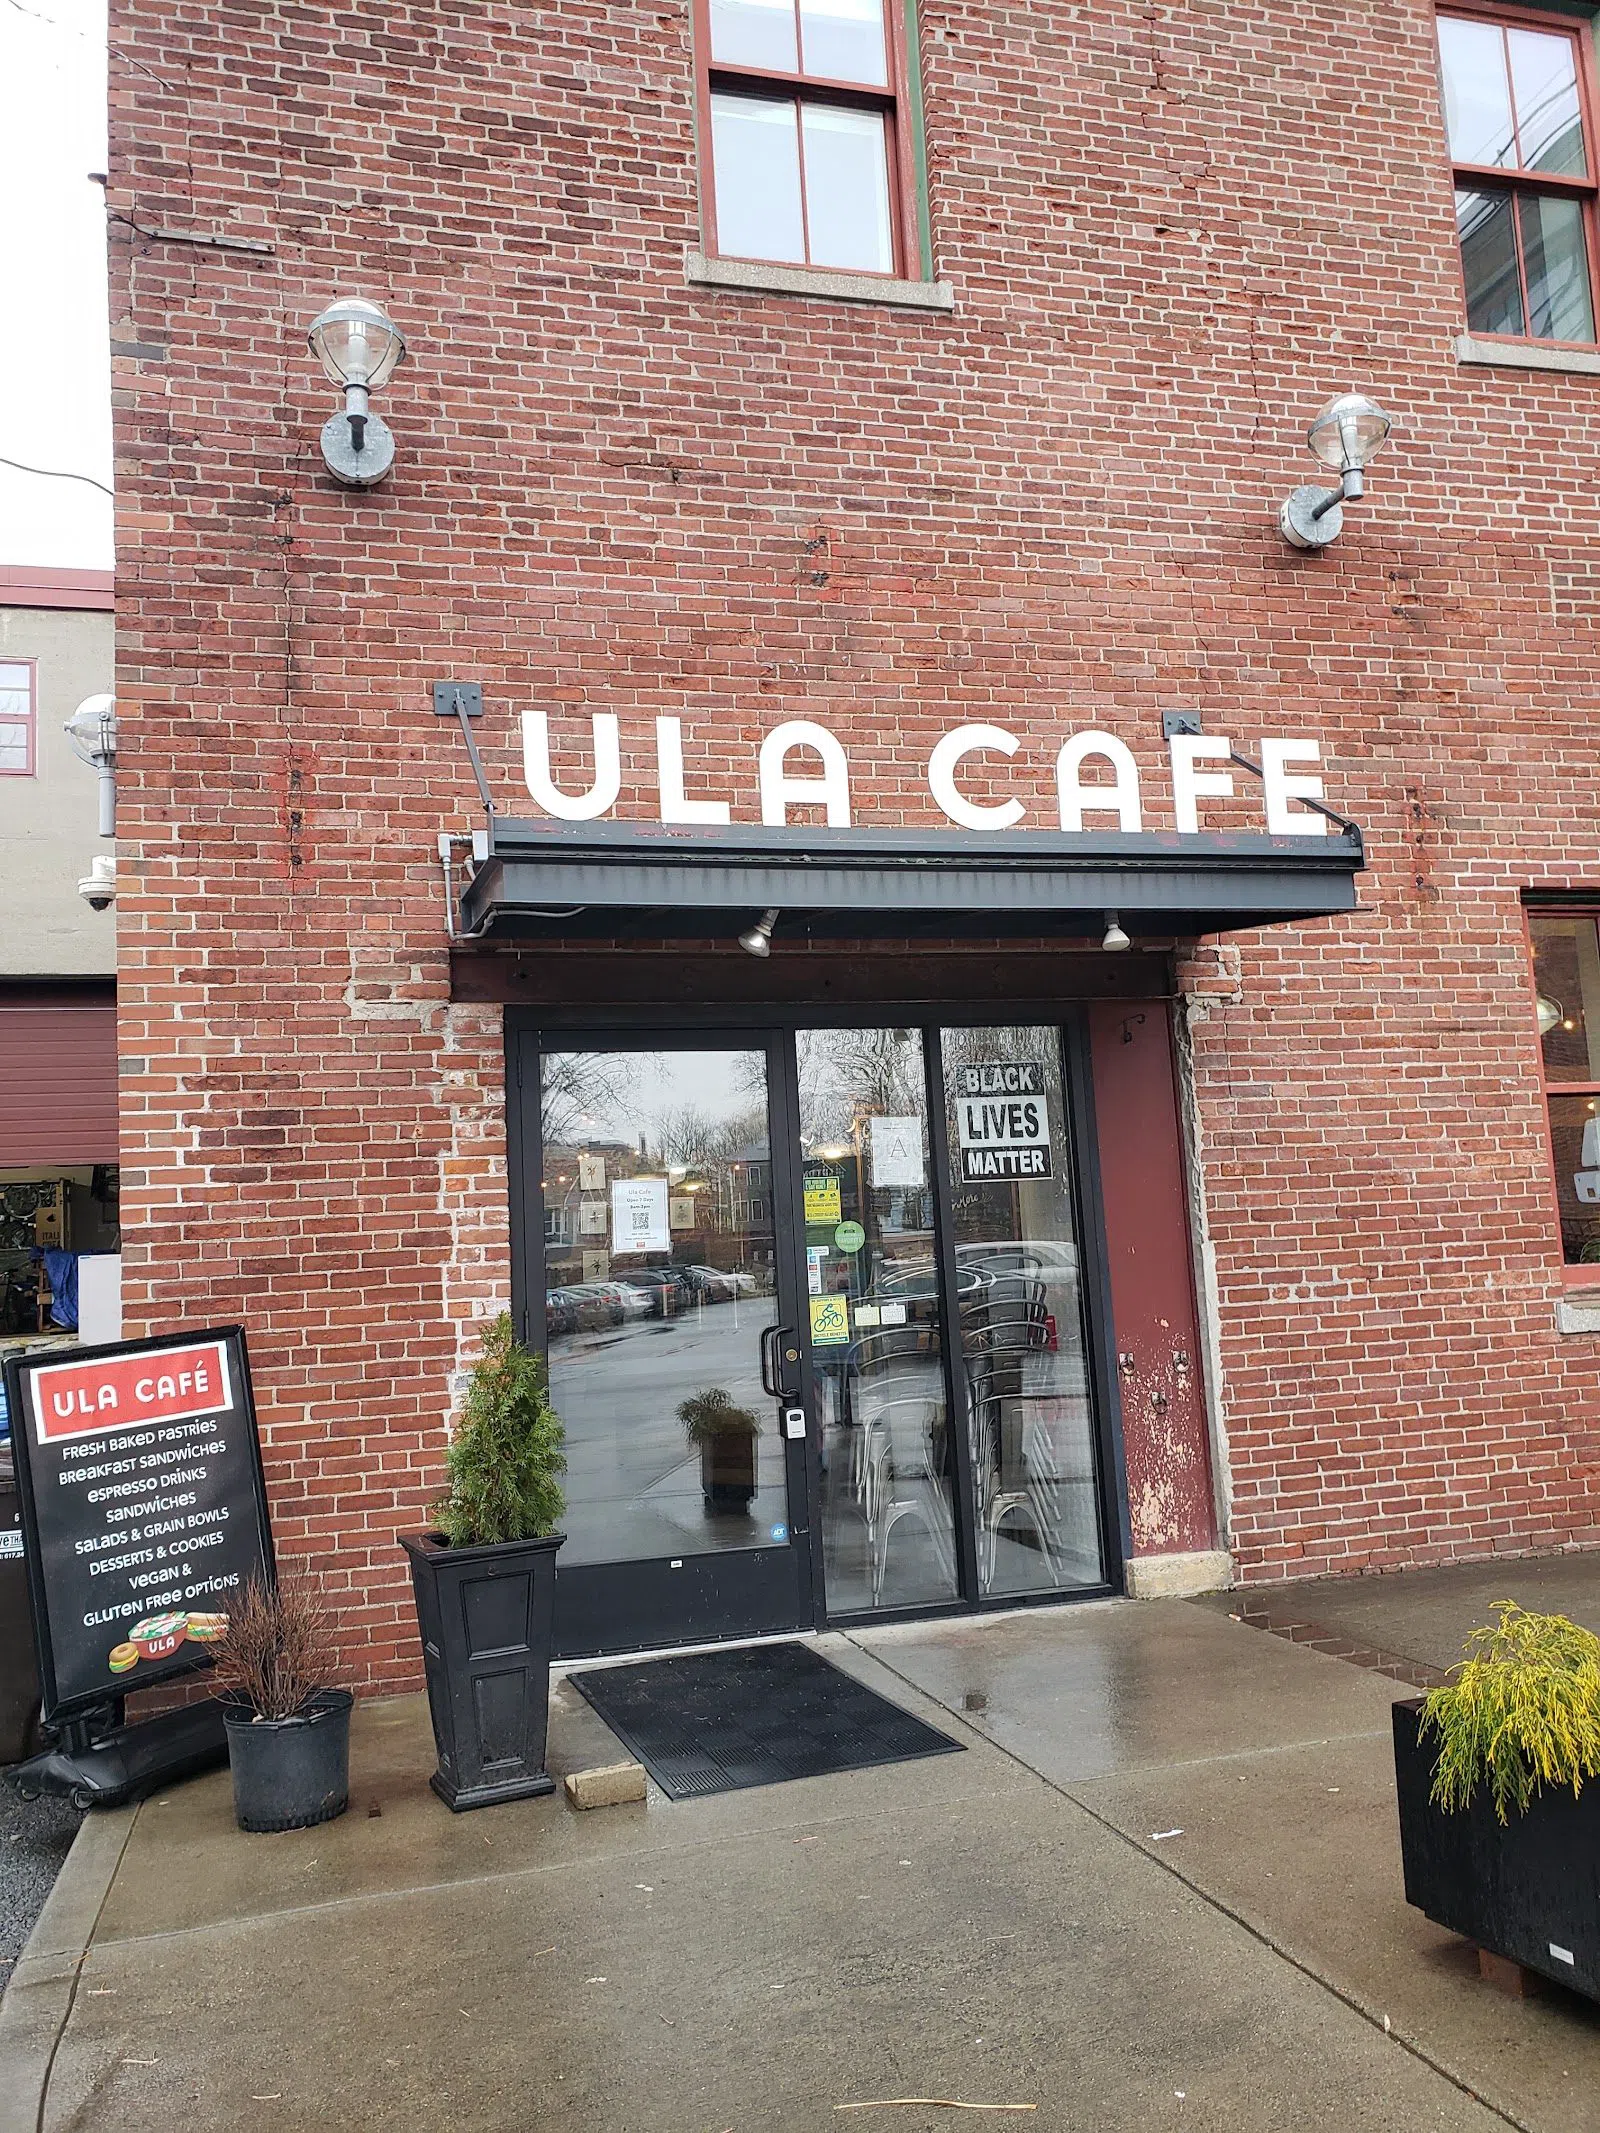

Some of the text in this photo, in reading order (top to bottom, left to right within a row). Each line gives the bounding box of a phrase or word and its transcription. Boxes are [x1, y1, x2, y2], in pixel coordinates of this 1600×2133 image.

[521, 709, 1328, 836] ULA CAFE
[965, 1066, 1034, 1093] BLACK
[966, 1102, 1040, 1139] LIVES
[890, 1136, 909, 1157] A
[967, 1149, 1046, 1175] MATTER
[53, 1360, 210, 1418] ULA CAFÉ
[130, 1528, 142, 1542] &
[144, 1517, 185, 1539] GRAIN
[187, 1507, 230, 1528] BOWLS
[89, 1531, 225, 1576] DESSERTS & COOKIES
[182, 1563, 193, 1576] &
[148, 1636, 175, 1655] ULA
